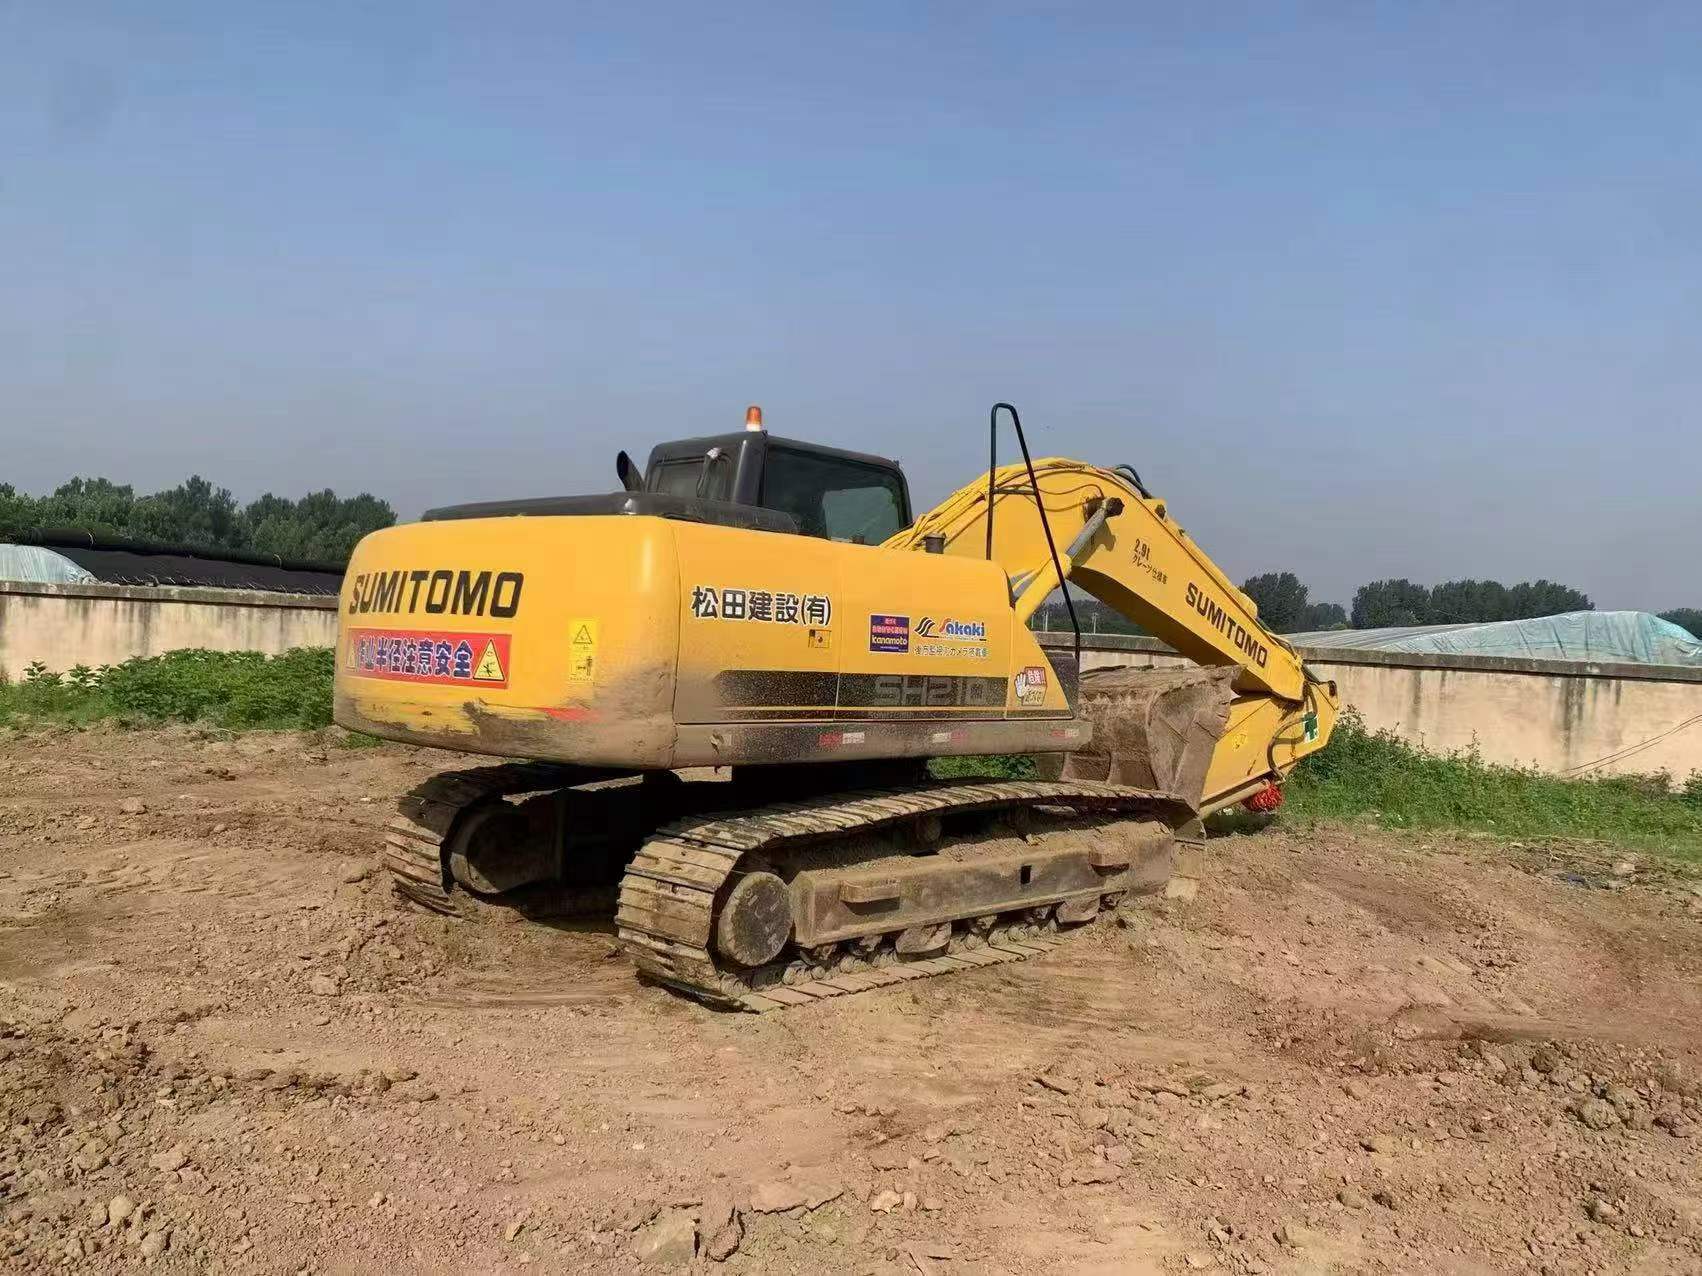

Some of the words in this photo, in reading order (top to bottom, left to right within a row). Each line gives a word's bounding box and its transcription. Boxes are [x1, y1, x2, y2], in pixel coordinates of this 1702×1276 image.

[348, 570, 525, 619] SUMITOMO
[691, 585, 832, 626] 松田建設(有)
[1185, 582, 1268, 669] SUMITOMO
[875, 675, 987, 706] SH210
